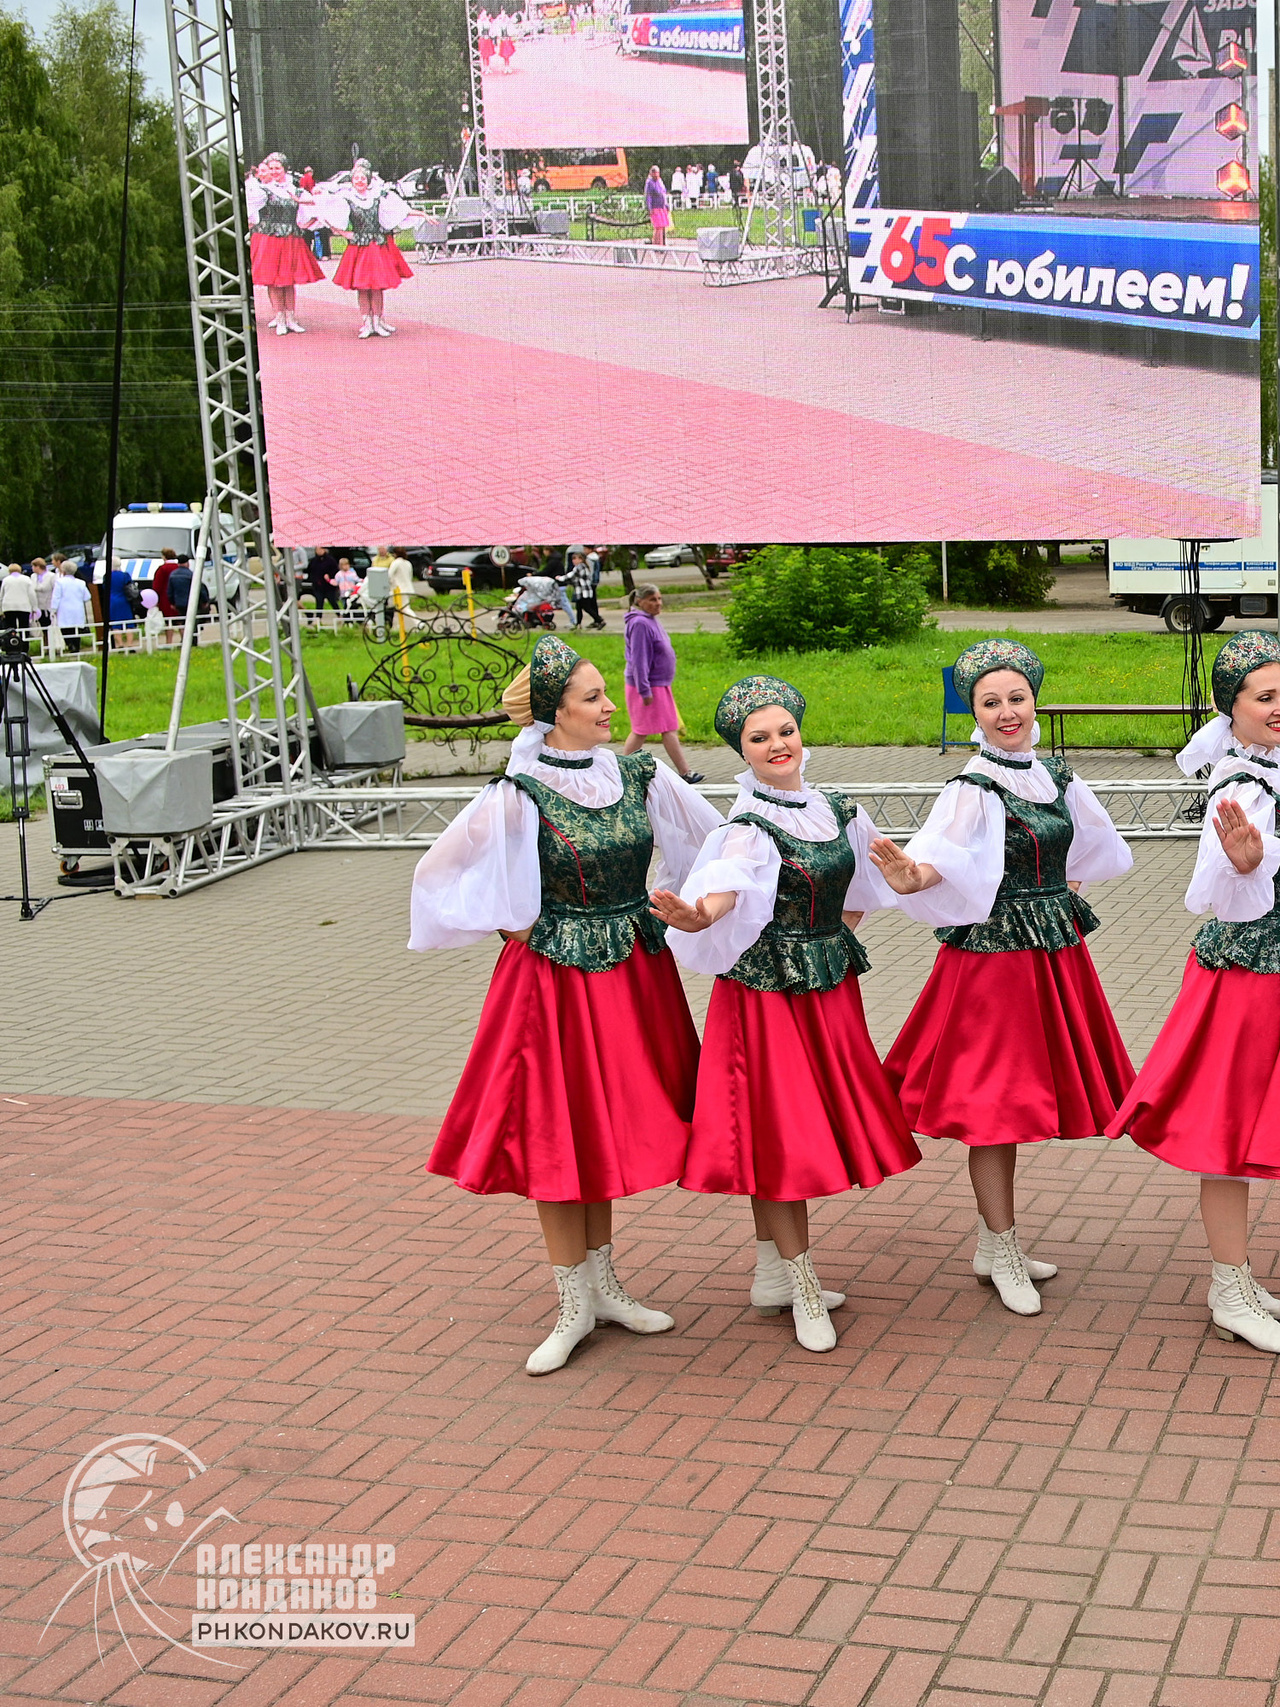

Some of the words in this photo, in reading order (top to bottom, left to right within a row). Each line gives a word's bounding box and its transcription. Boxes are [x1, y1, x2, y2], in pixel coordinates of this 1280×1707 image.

[660, 25, 741, 51] юбилеем!
[880, 216, 953, 287] 65
[944, 244, 978, 291] С
[985, 250, 1250, 320] юбилеем!
[494, 550, 507, 559] 40
